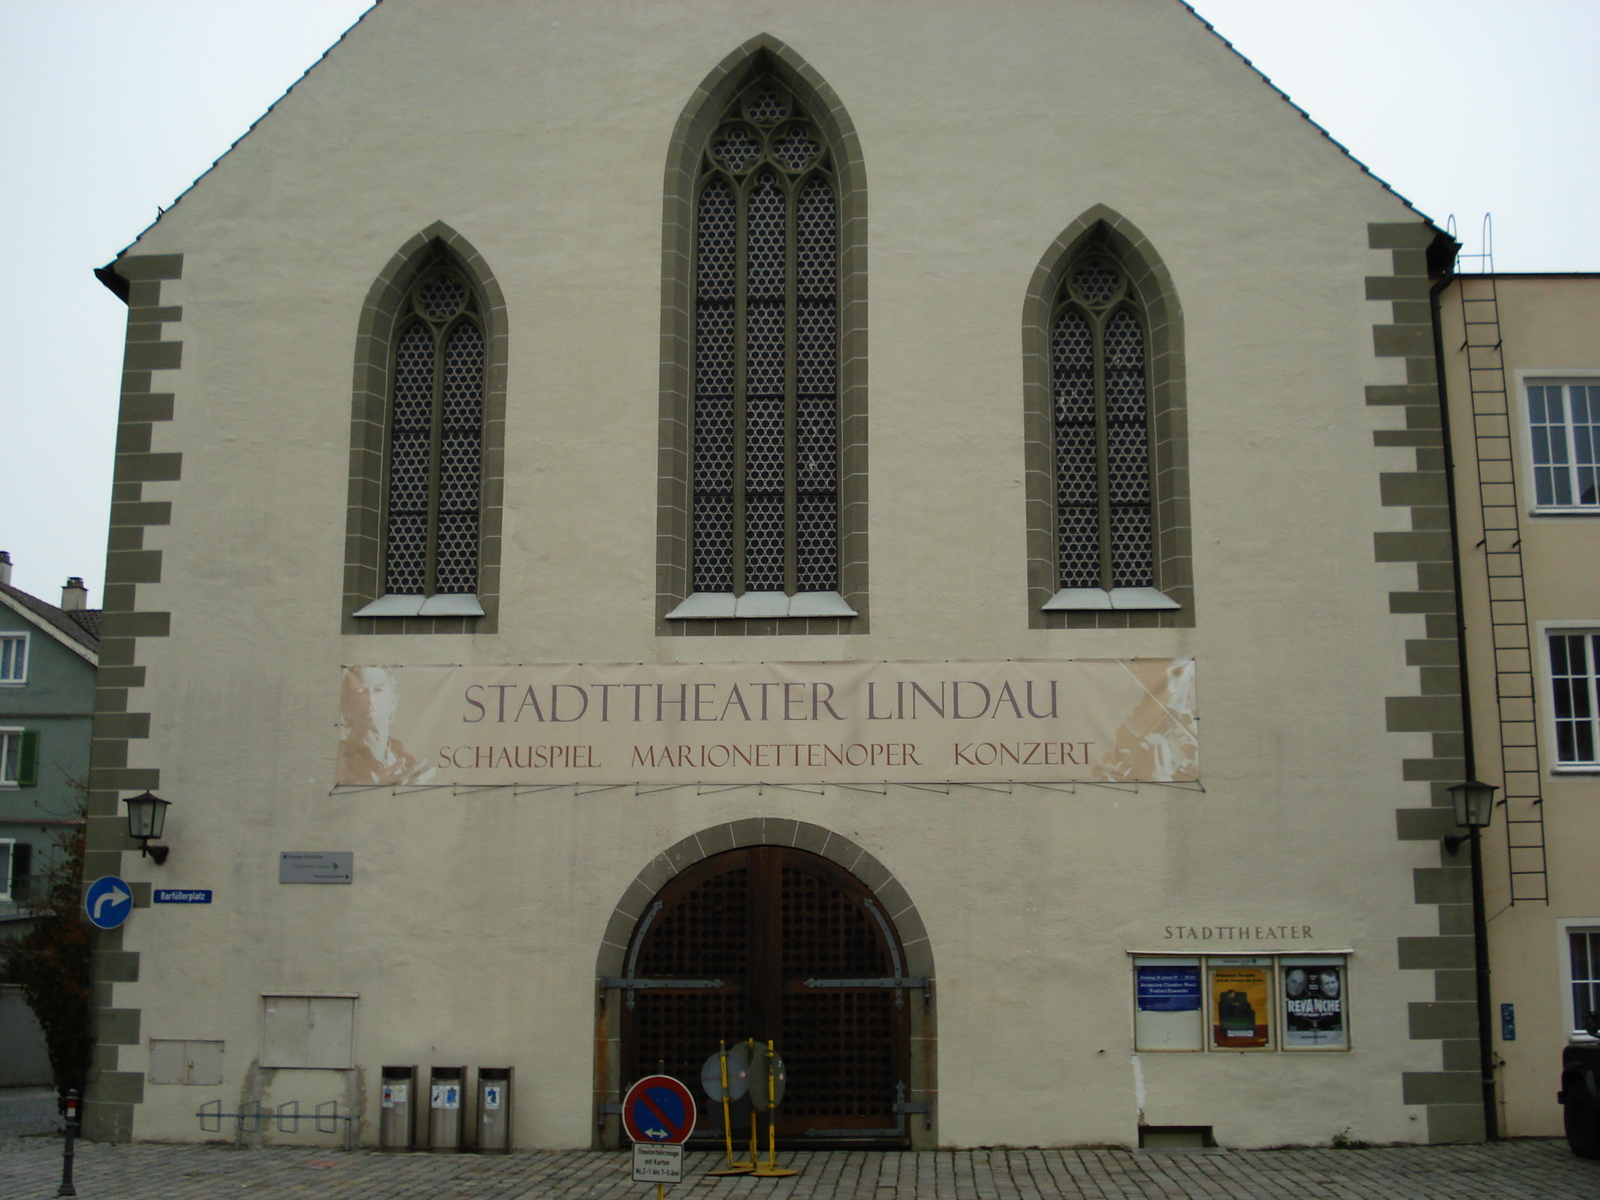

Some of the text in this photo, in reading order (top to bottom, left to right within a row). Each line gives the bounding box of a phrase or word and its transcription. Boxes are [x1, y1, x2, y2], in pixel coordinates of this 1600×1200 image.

[463, 679, 1059, 723] STADTTHEATER LINDAU
[437, 741, 1095, 769] SCHAUSPIEL MARIONETTENOPER KONZERT
[1164, 925, 1314, 940] STADTTHEATER
[1288, 998, 1341, 1013] REVANCHE
